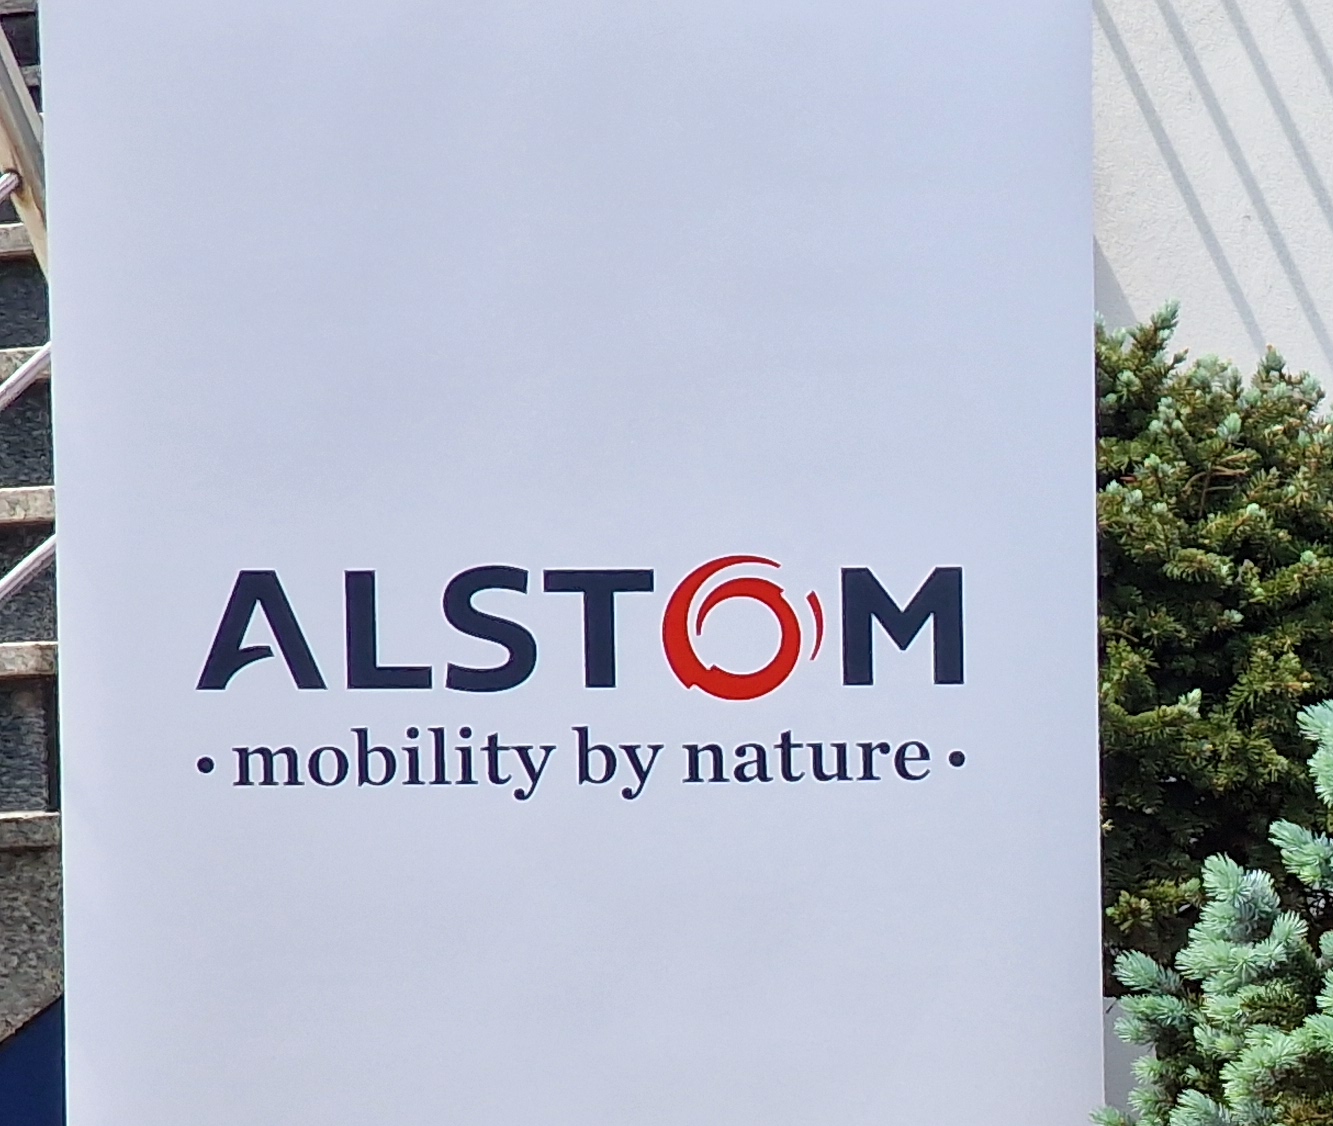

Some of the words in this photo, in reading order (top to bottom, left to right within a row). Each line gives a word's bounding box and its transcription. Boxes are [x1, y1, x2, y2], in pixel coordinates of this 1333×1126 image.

[195, 555, 965, 701] ALSTOM
[232, 726, 556, 801] mobility
[571, 725, 665, 800] by
[682, 730, 931, 783] nature
